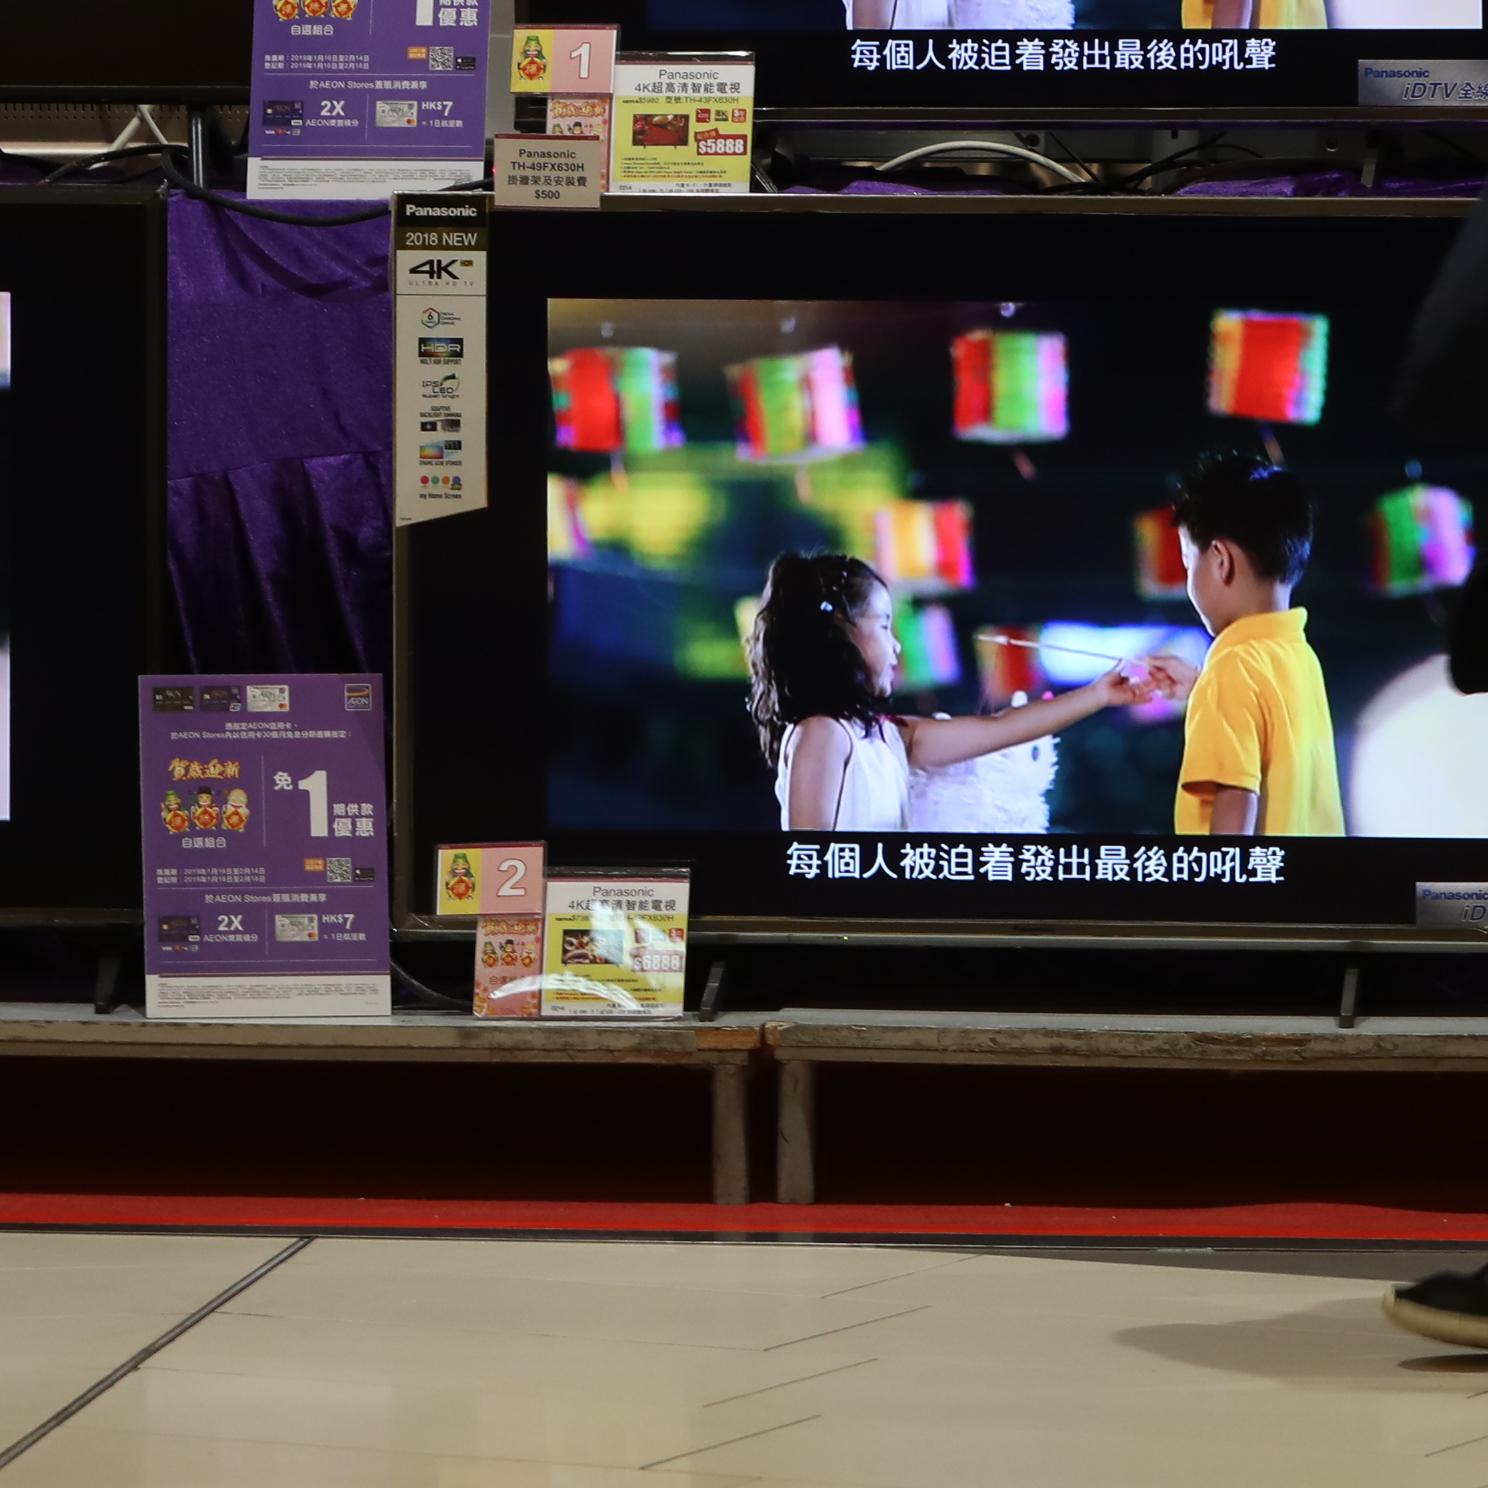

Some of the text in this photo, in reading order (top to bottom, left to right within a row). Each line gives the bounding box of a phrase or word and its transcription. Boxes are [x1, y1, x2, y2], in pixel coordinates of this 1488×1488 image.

[438, 8, 479, 27] 優惠
[290, 24, 335, 36] 自選組合
[570, 42, 591, 79] 1
[851, 38, 1277, 71] 每個人被迫着發出最後的吼聲
[658, 69, 720, 80] Panasonic
[1364, 67, 1430, 79] Panasonic
[634, 81, 741, 94] 4K超高清智能電視
[320, 100, 453, 116] 2X HK$7
[518, 148, 576, 159] Panasonic
[698, 139, 744, 154] $5888
[511, 161, 585, 172] TH-49FX630H
[535, 189, 560, 200] $500
[405, 204, 478, 217] Panasonic
[405, 232, 477, 246] 2018 NEW
[409, 259, 460, 280] 4K
[420, 343, 461, 353] HDR
[273, 770, 328, 837] 免 1
[333, 803, 375, 816] 期供款
[332, 818, 375, 837] 優惠
[181, 837, 227, 849] 自選組合
[786, 842, 1286, 883] 每個人被迫着發出最後的吼聲
[497, 858, 526, 897] 2
[592, 886, 654, 897] Panasonic
[217, 914, 355, 931] 2X HK$7
[634, 954, 681, 971] $6888
